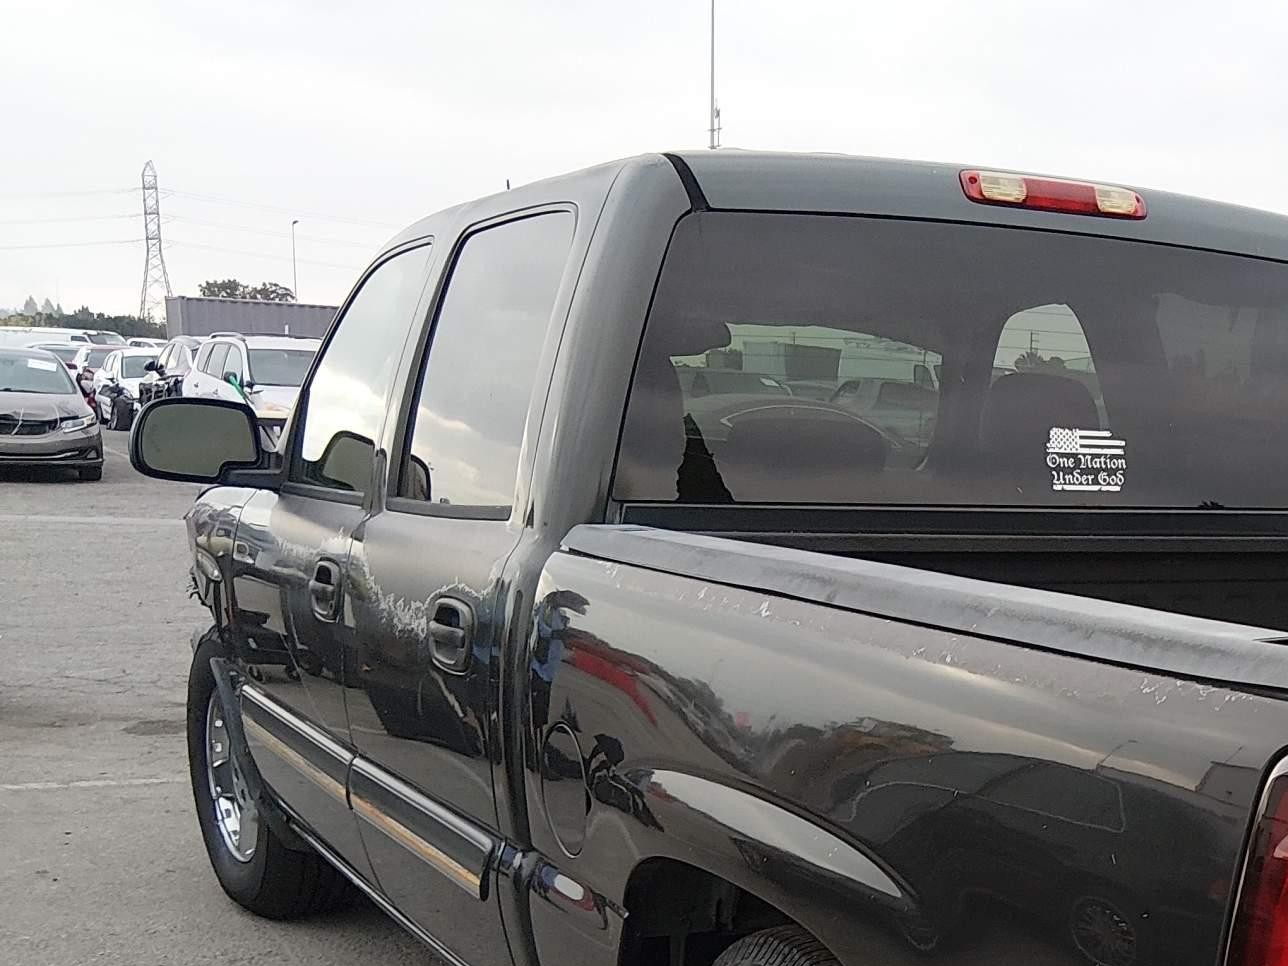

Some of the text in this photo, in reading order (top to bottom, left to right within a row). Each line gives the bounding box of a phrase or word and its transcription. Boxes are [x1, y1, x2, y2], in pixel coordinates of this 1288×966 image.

[1046, 453, 1127, 470] One Nation
[1051, 469, 1125, 486] Under God
